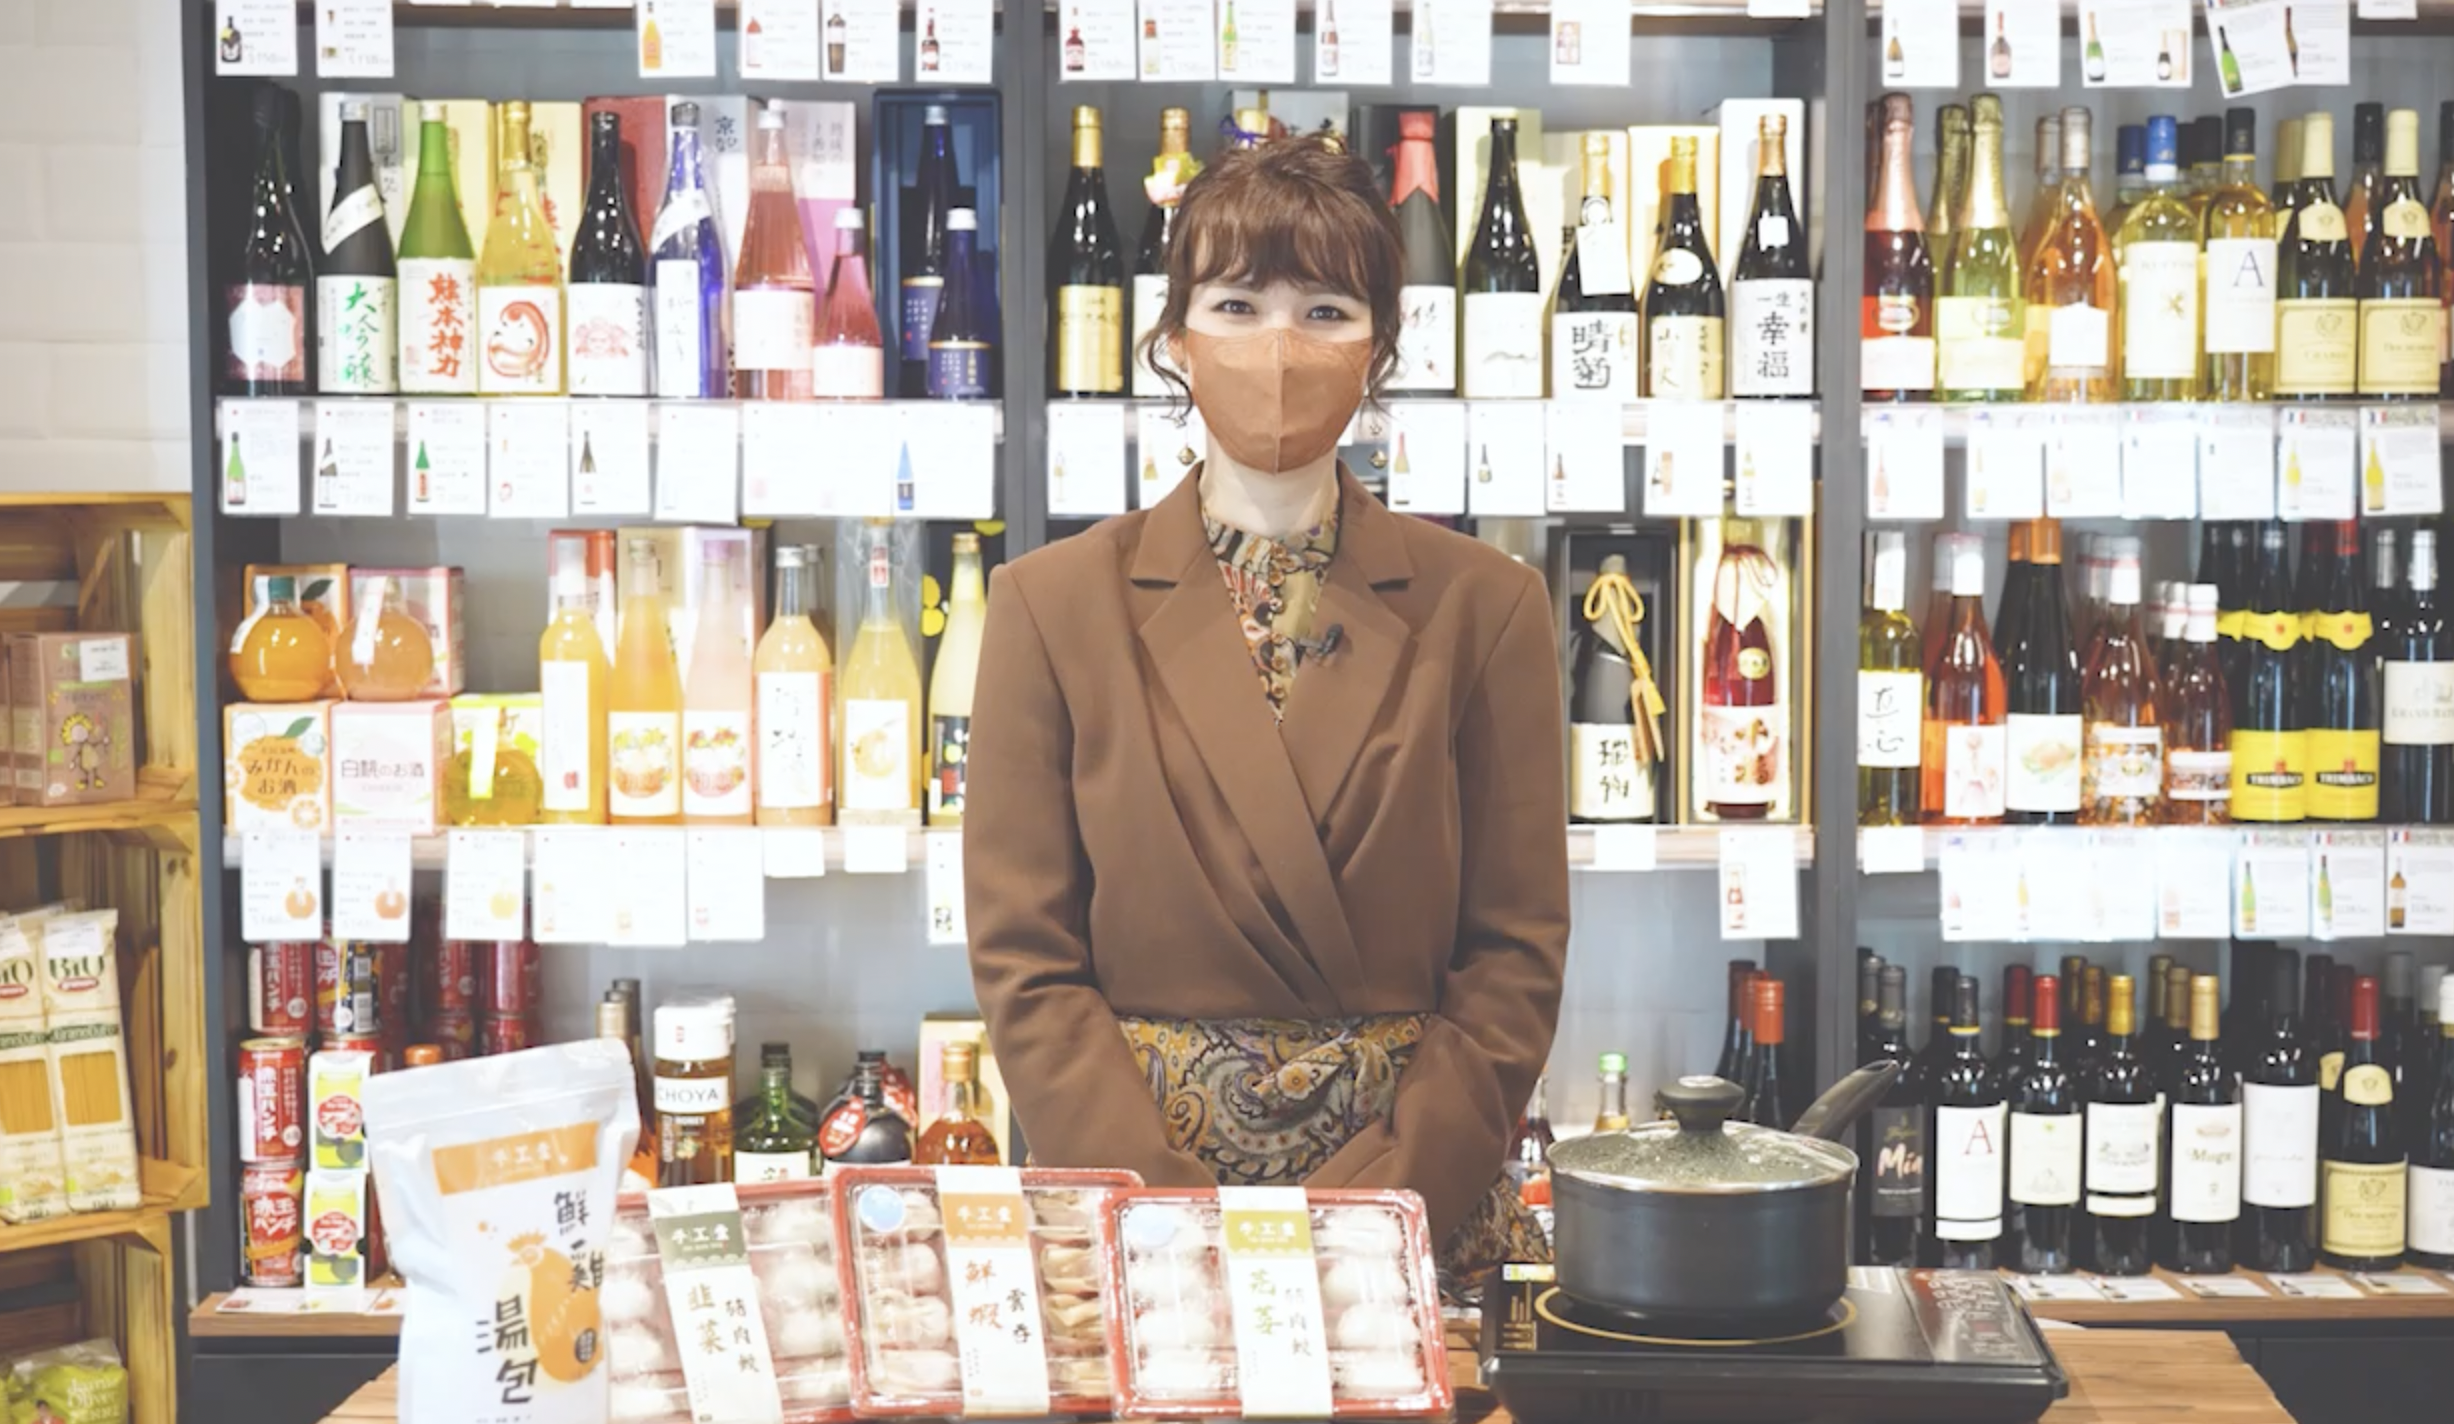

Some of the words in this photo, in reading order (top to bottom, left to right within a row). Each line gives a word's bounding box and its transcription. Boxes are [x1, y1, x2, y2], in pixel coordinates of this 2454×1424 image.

[2232, 249, 2265, 288] A
[428, 273, 464, 379] 熊本神力
[1757, 311, 1790, 378] 幸福
[246, 758, 314, 776] みかんの
[258, 778, 297, 795] お酒
[657, 1086, 719, 1104] CHOYA
[1963, 1120, 1994, 1155] A
[687, 1283, 727, 1354] 韭菜
[965, 1259, 1005, 1329] 鮮蝦
[475, 1294, 541, 1405] 湯包
